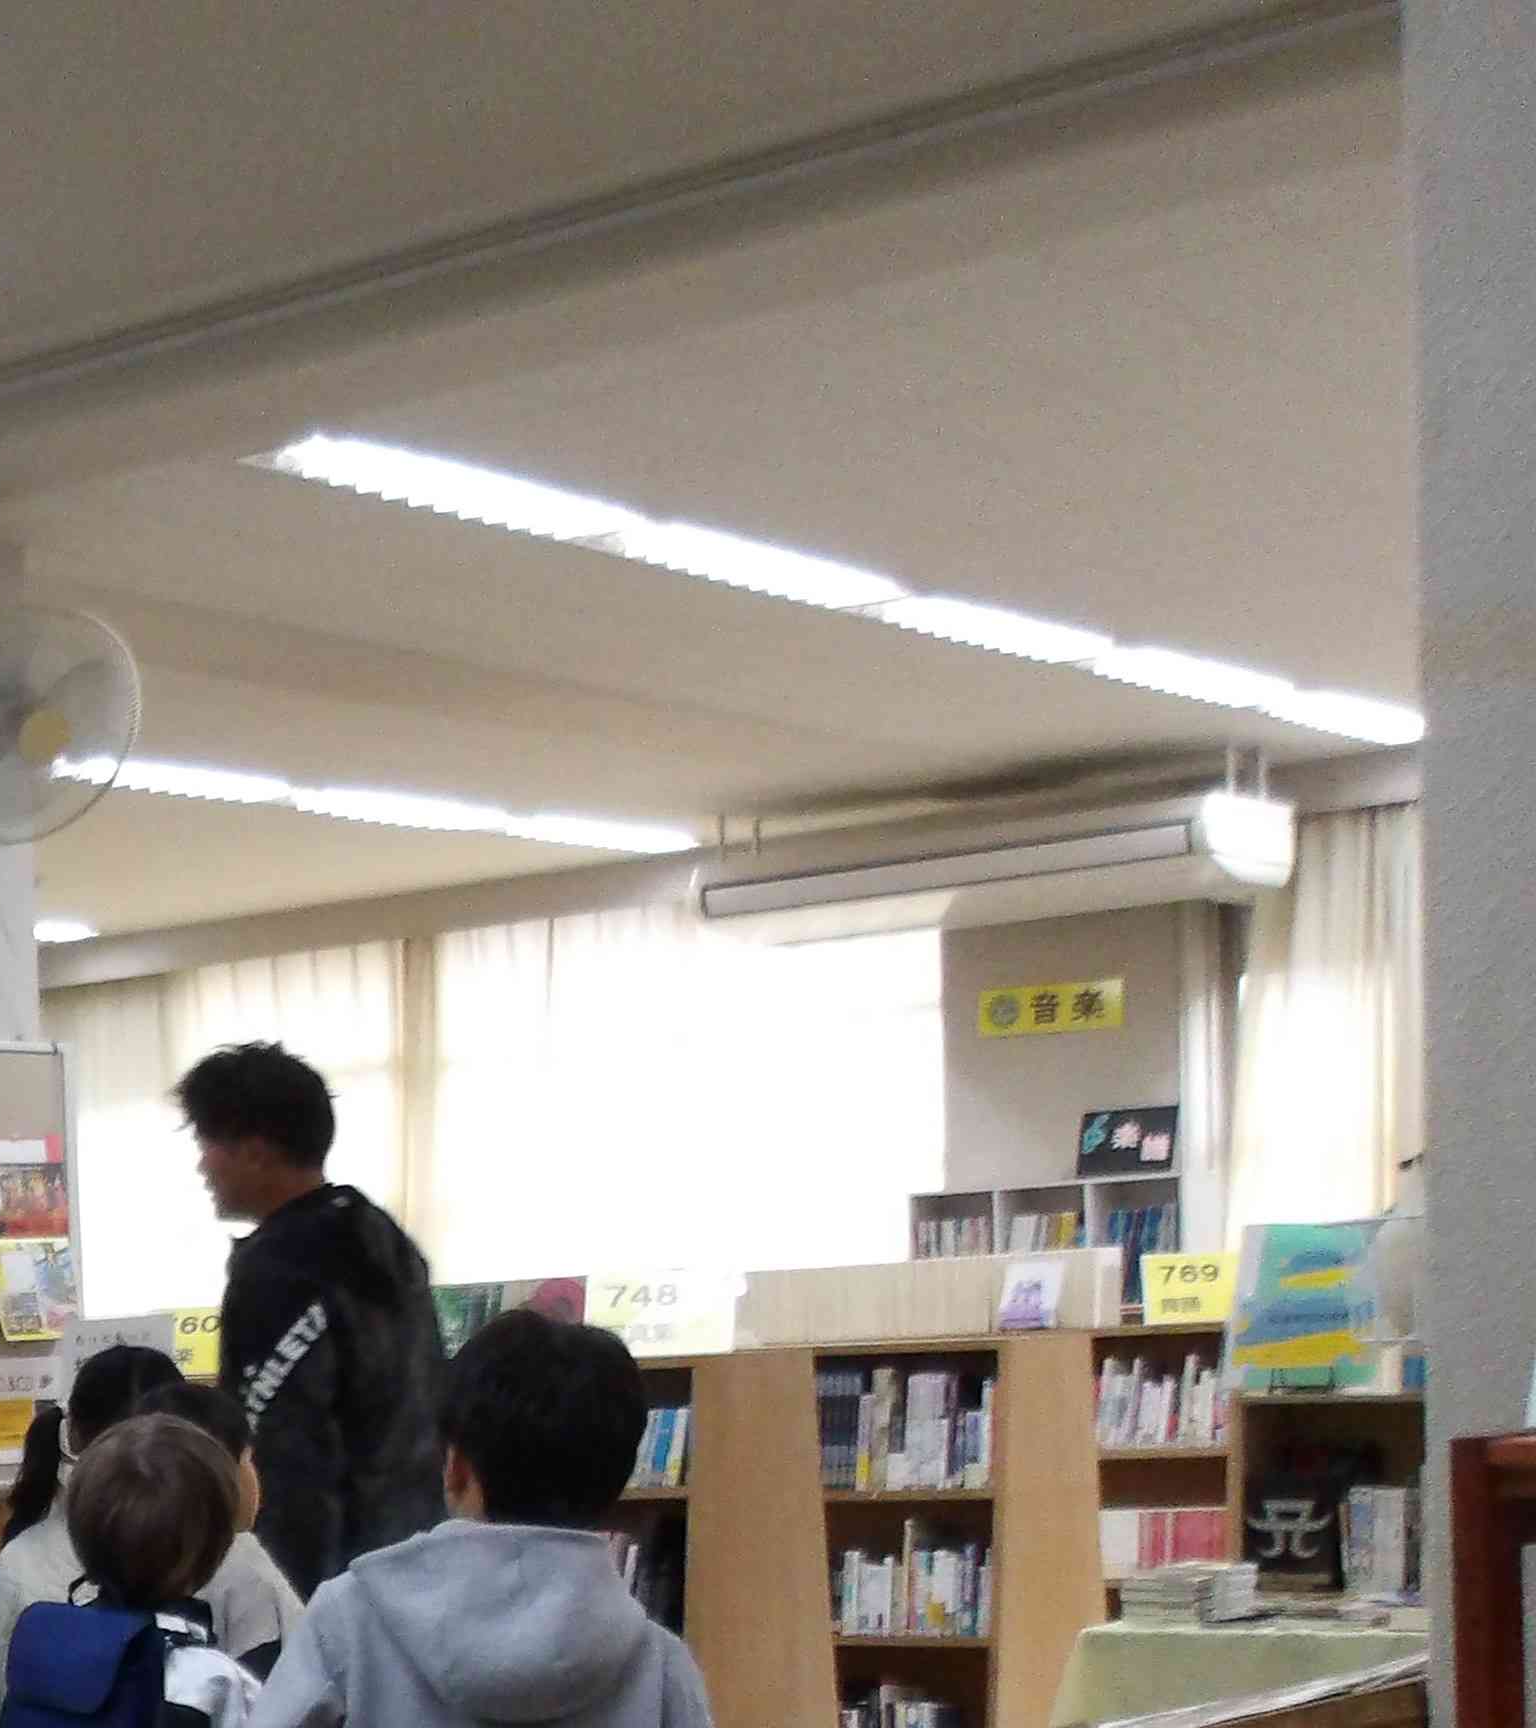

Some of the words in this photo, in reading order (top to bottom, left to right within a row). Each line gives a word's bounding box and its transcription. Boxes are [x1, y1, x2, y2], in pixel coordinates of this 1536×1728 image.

[1030, 990, 1105, 1024] 音楽
[1159, 1263, 1219, 1285] 769
[604, 1284, 679, 1308] 748
